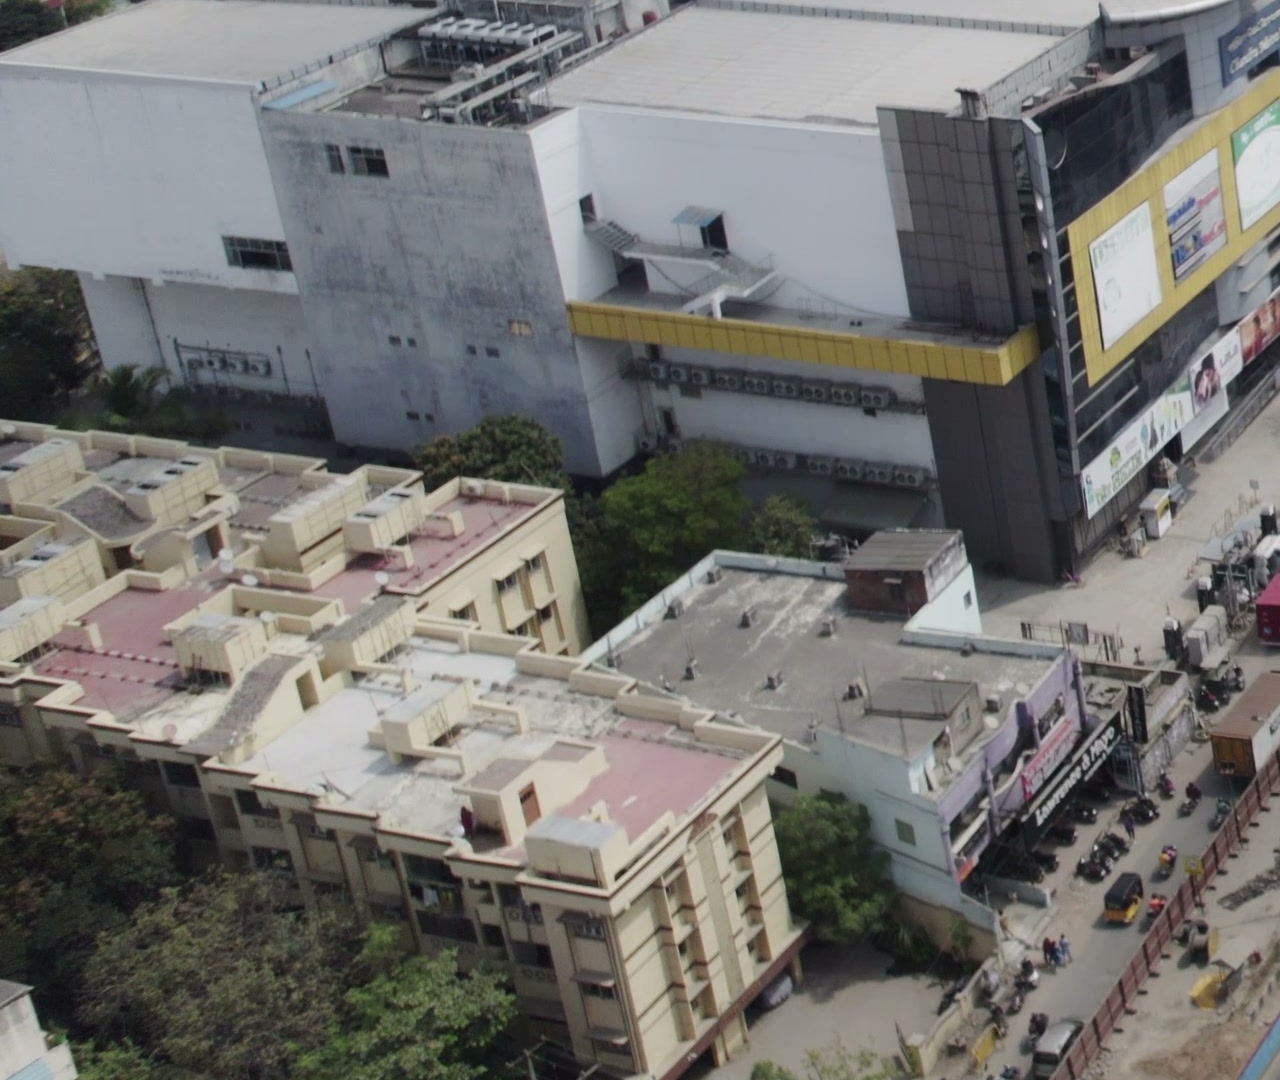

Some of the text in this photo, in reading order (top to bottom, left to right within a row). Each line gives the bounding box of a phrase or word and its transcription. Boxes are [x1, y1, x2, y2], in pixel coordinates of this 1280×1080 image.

[1035, 766, 1083, 827] Lawrence
[1081, 754, 1091, 771] &
[1089, 726, 1115, 764] Mayo
